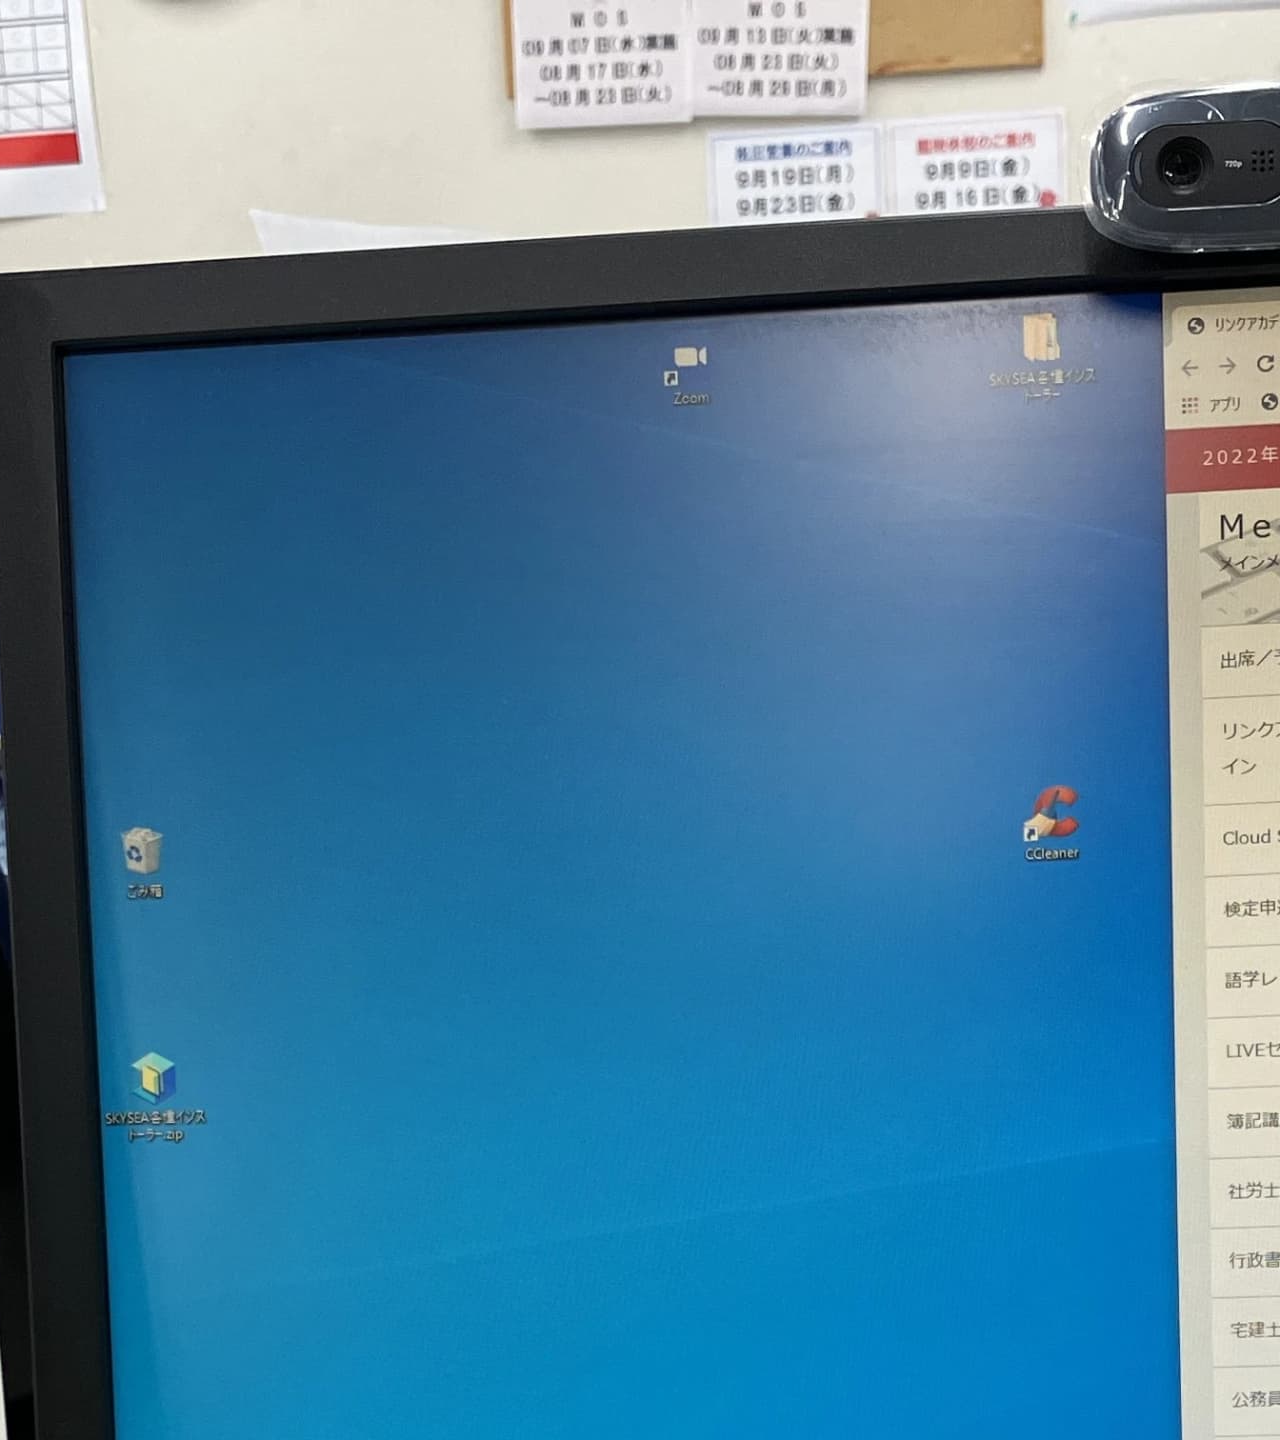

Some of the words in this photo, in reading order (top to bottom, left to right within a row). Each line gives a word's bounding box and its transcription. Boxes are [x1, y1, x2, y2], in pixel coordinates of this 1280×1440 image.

[1224, 159, 1243, 169] 720p
[1210, 397, 1241, 412] アプリ
[1222, 759, 1257, 776] イン
[1223, 829, 1271, 846] Cloud
[1025, 848, 1079, 860] CCleaner
